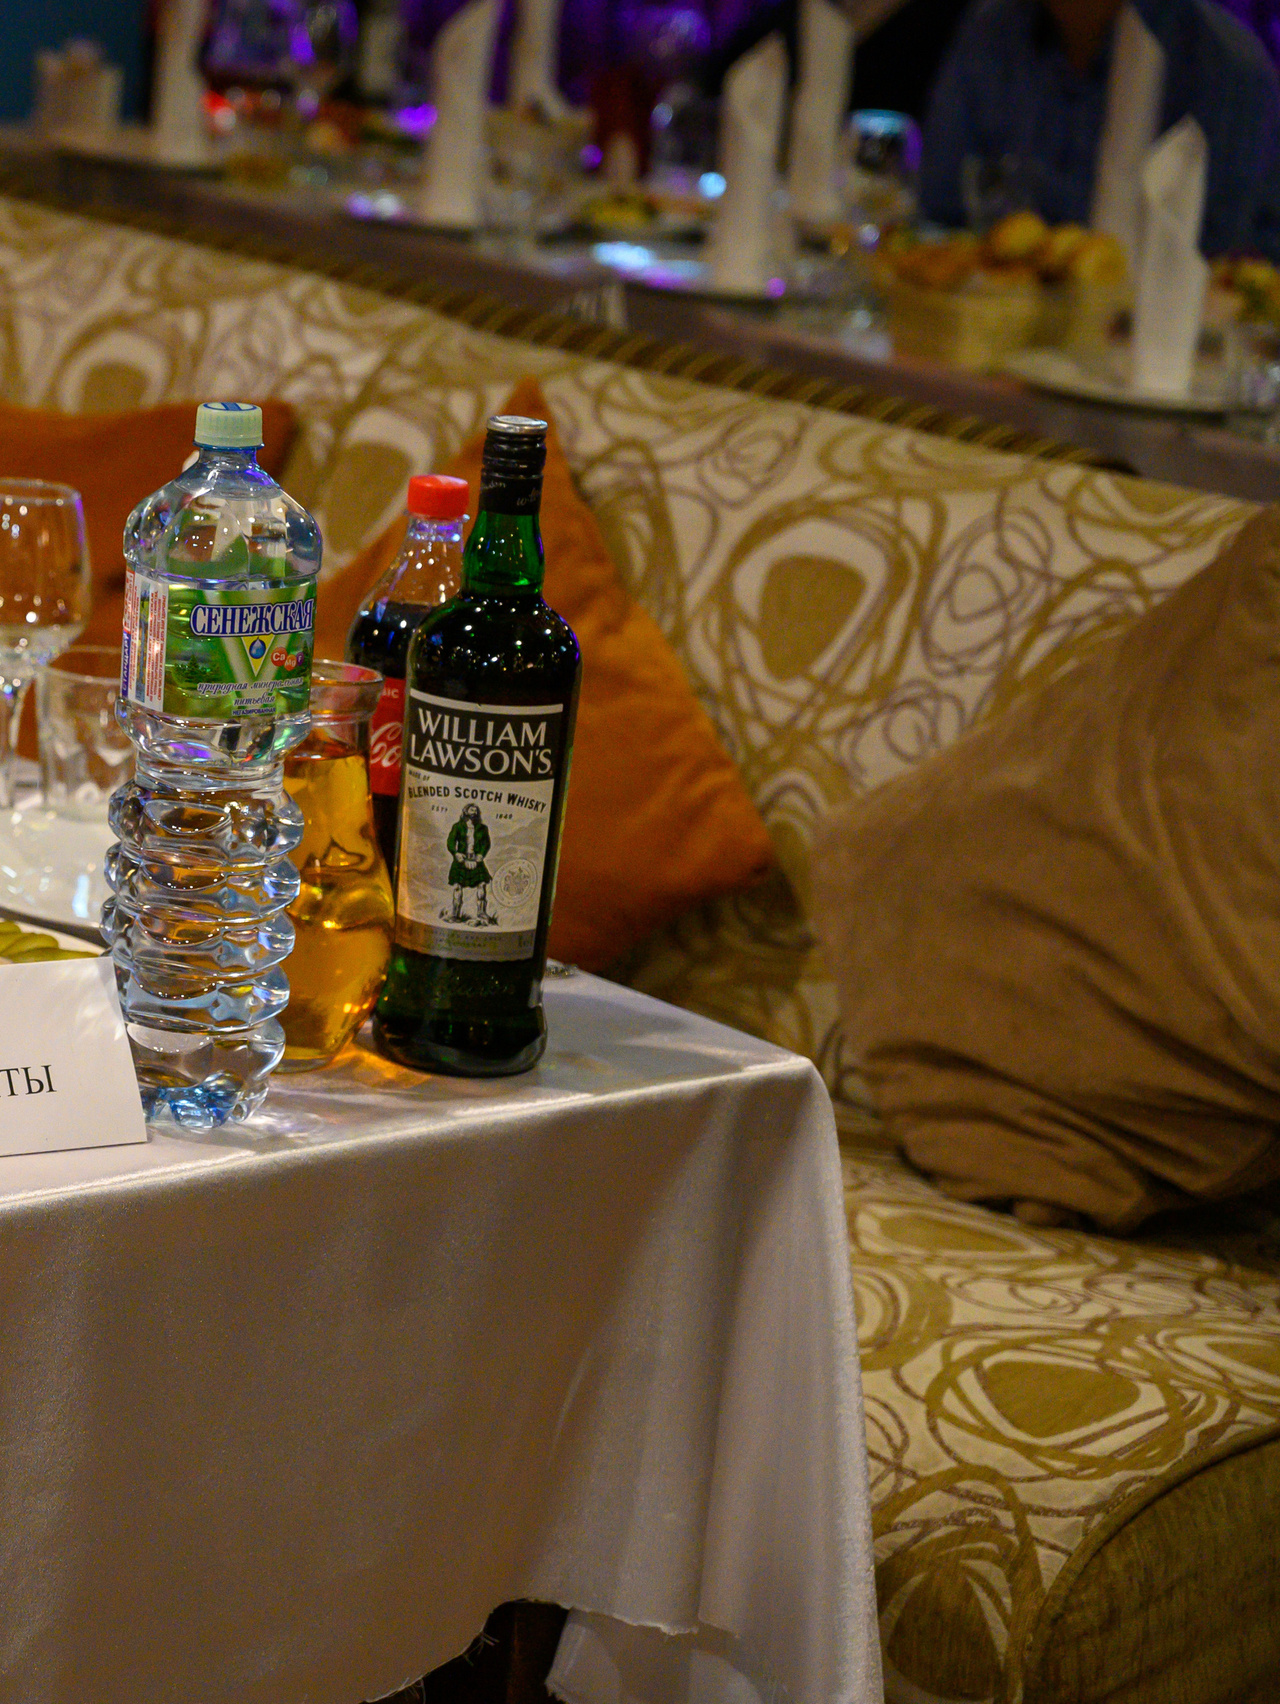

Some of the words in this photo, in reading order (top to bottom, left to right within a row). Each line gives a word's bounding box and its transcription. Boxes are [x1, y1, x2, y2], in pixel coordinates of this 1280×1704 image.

[191, 599, 314, 636] СЕНЕЖСКАЯ
[272, 652, 286, 661] Ca
[285, 659, 296, 668] Mg
[197, 682, 249, 696] природная
[251, 677, 303, 692] минеральная
[234, 692, 276, 706] питьевая
[232, 707, 276, 716] НЕГАЗИРОВАННАЯ
[418, 707, 547, 747] WILLIAM
[411, 733, 552, 775] LAWSON'S
[408, 785, 450, 798] BLENDED
[454, 786, 503, 803] SCOTCH
[507, 792, 547, 814] WHISKY
